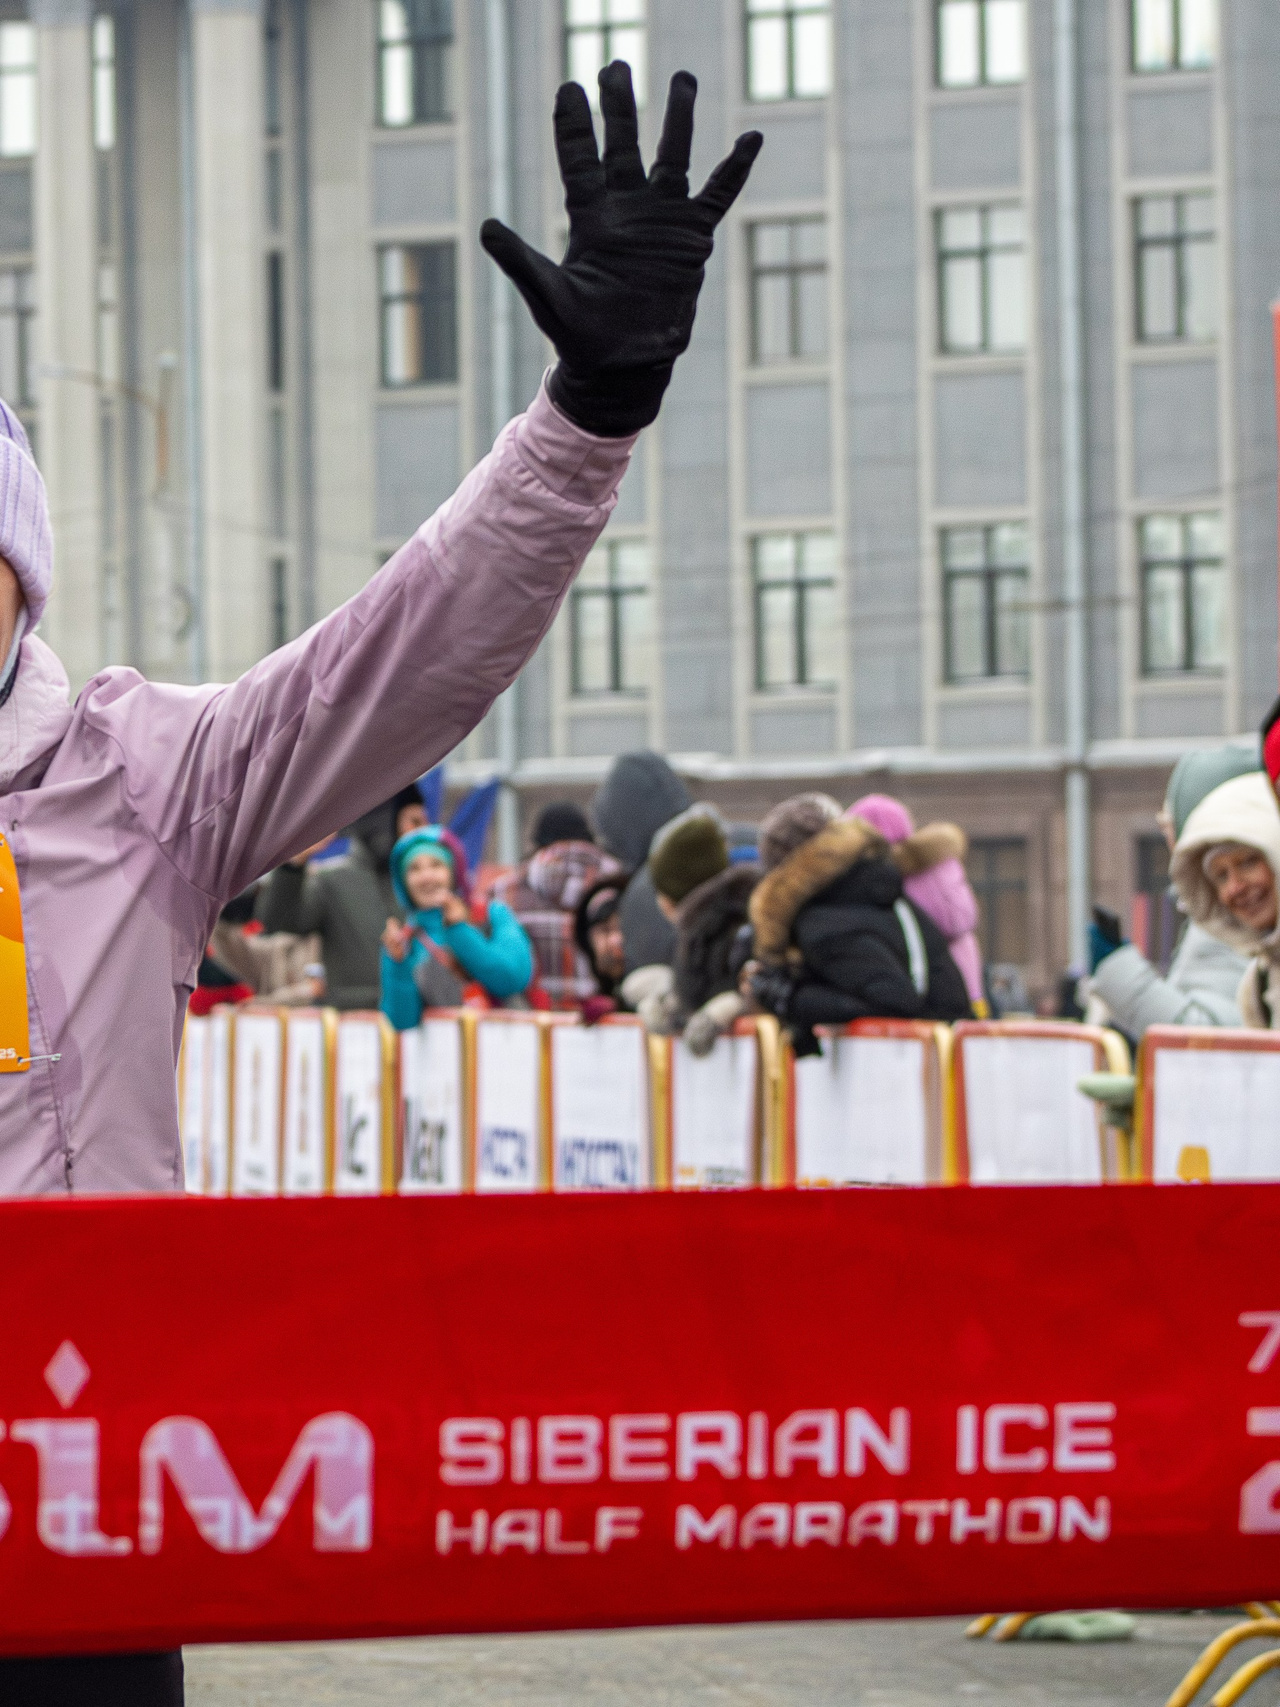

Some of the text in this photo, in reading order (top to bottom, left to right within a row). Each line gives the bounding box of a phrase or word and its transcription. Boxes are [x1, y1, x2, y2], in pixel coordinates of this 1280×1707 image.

[438, 1401, 1117, 1486] SIBERIAN ICE
[434, 1496, 1111, 1557] HALF MARATHON
